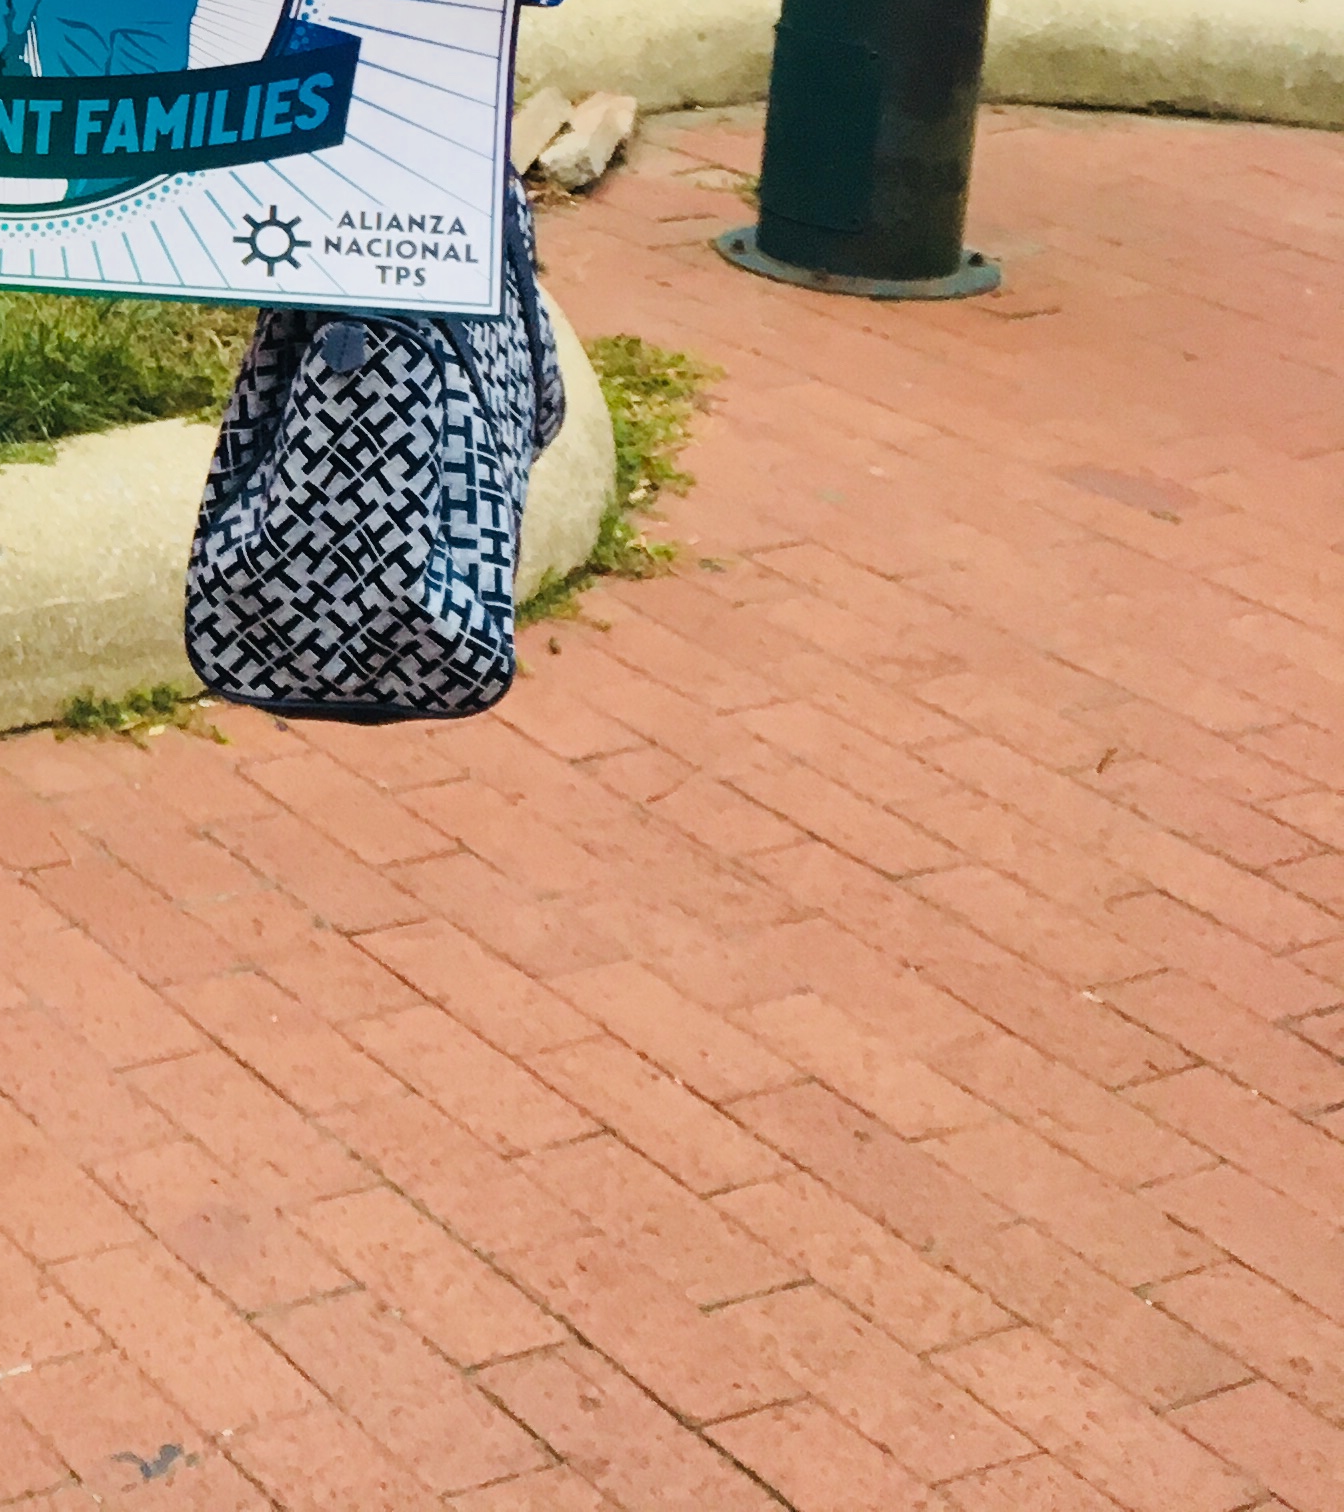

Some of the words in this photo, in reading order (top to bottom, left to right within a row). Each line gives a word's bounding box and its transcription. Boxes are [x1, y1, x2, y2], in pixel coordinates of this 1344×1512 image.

[72, 72, 334, 156] FAMILIES
[337, 209, 468, 236] ALIANZA
[323, 235, 479, 264] NACIONAL
[375, 264, 427, 287] TPS
